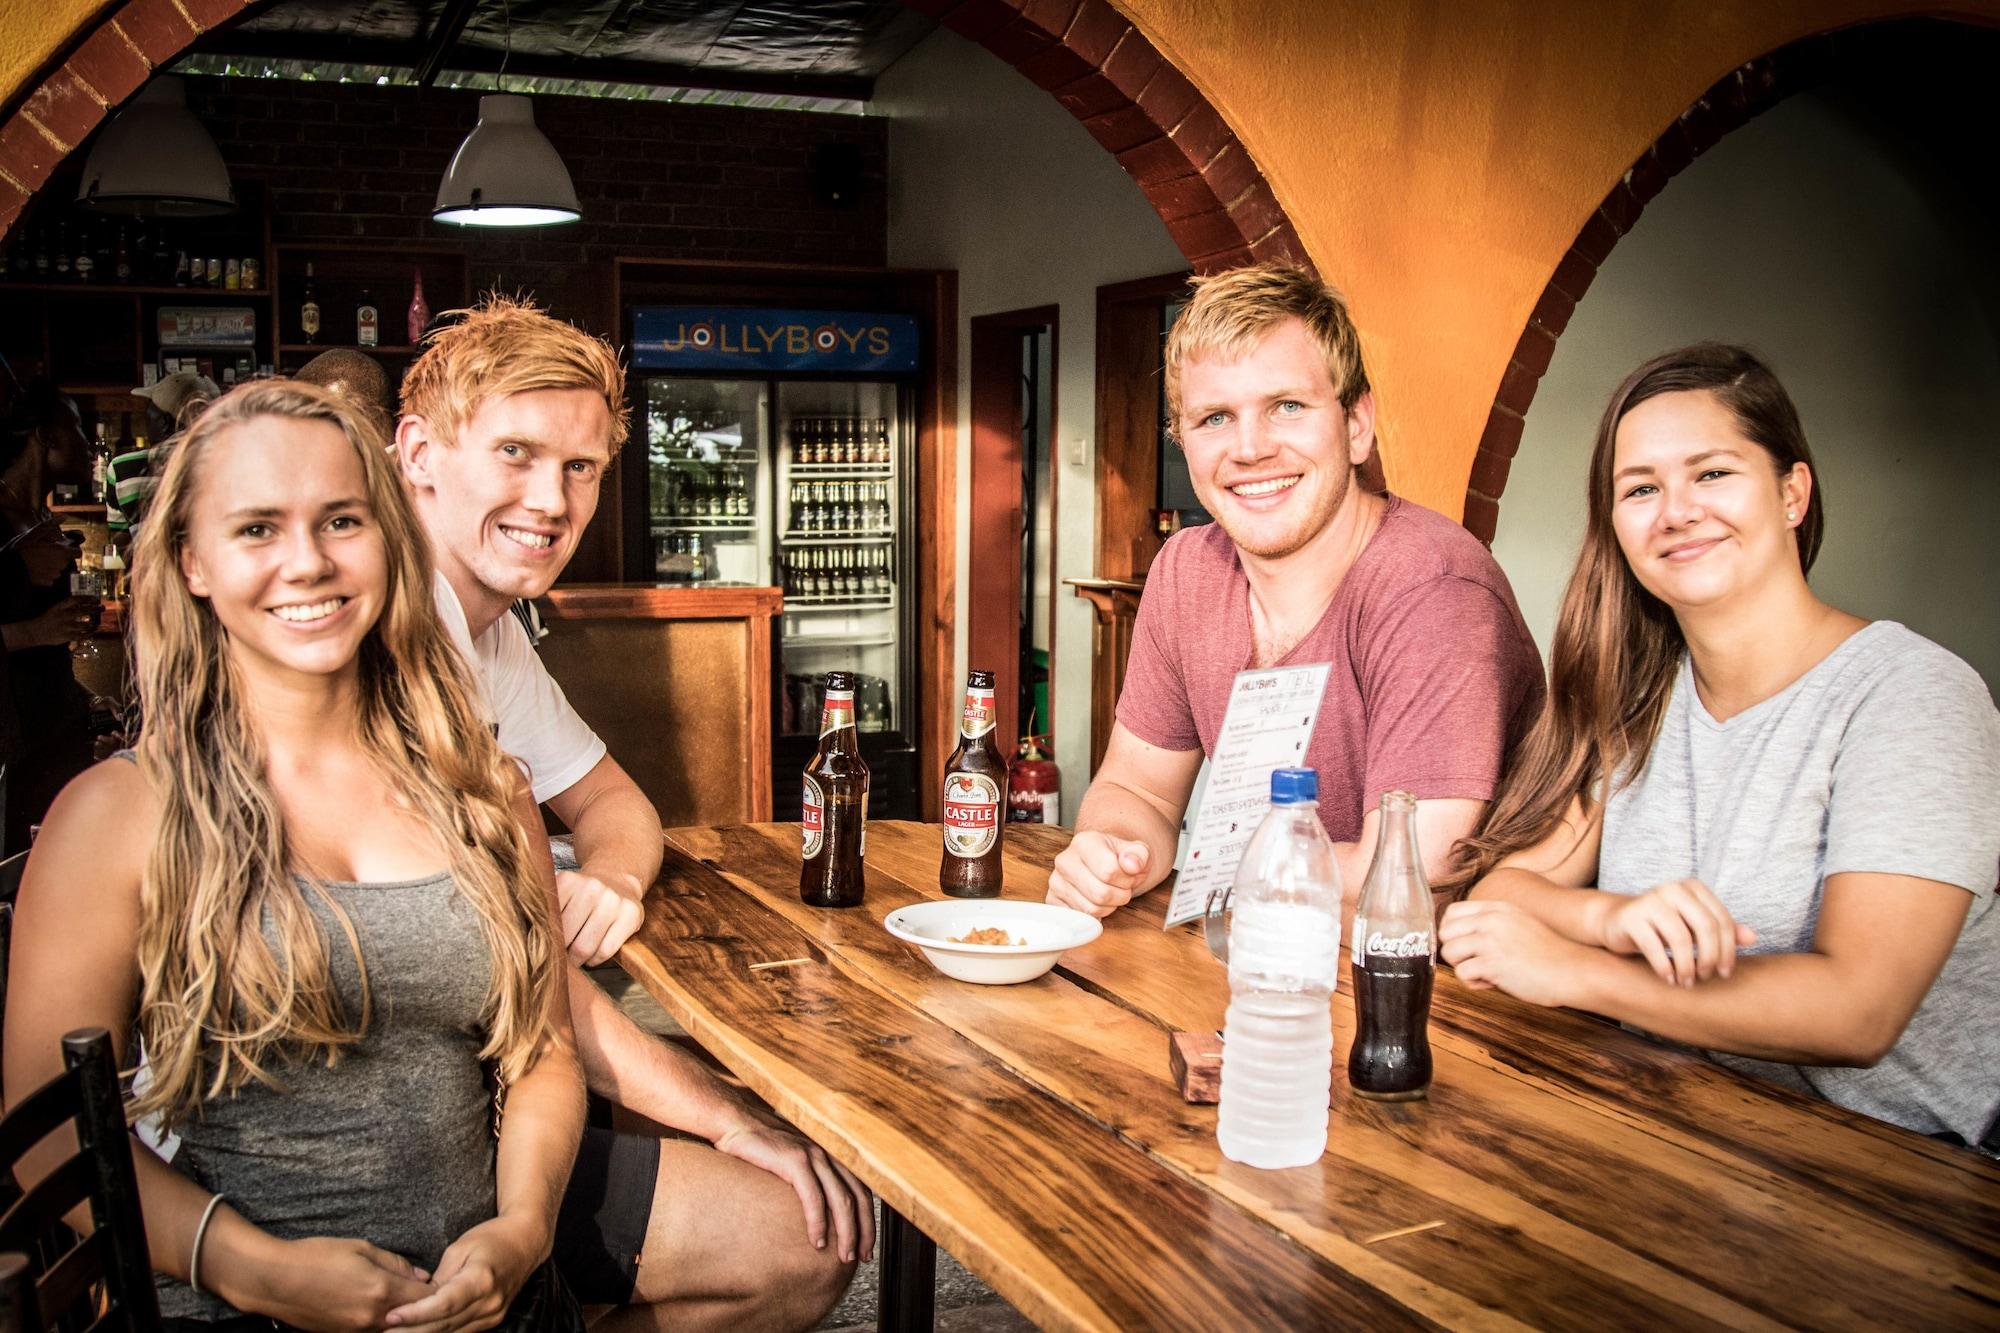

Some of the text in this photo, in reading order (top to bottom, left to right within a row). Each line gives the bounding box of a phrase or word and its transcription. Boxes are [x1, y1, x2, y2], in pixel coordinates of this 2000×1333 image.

[663, 321, 890, 355] JOLLYBOYS
[964, 709, 985, 717] CASTLE
[946, 806, 992, 821] CASTLE
[1366, 930, 1430, 957] Coca-Cola
